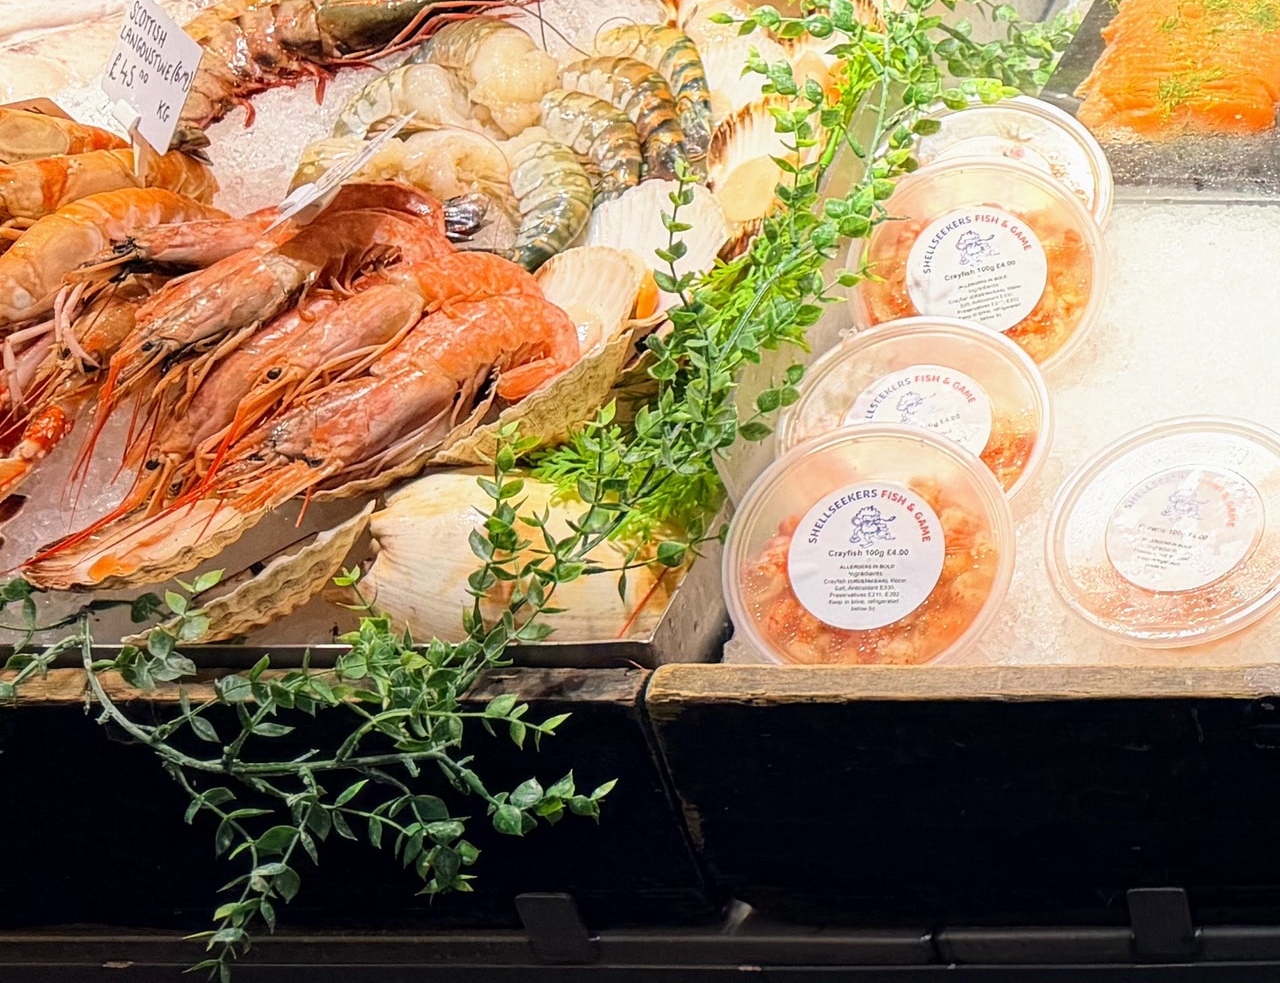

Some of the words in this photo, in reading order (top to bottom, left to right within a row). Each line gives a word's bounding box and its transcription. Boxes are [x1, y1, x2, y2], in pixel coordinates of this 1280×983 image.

[129, 0, 167, 49] SCOTTISH
[923, 215, 972, 274] SHELLSEEKERS
[974, 214, 1000, 225] FISH
[1001, 220, 1009, 228] &
[1010, 224, 1032, 251] GAME
[944, 268, 976, 282] Crayfish
[977, 265, 996, 277] 100g
[914, 374, 940, 384] FISH
[942, 377, 950, 385] &
[952, 380, 977, 404] GAME
[808, 488, 878, 545] SHELLSEEKERS
[881, 489, 907, 505] FISH
[906, 502, 916, 513] &
[913, 510, 931, 543] GAME
[828, 549, 863, 558] Crayfish
[865, 549, 885, 558] 100g
[886, 548, 909, 556] £4.00
